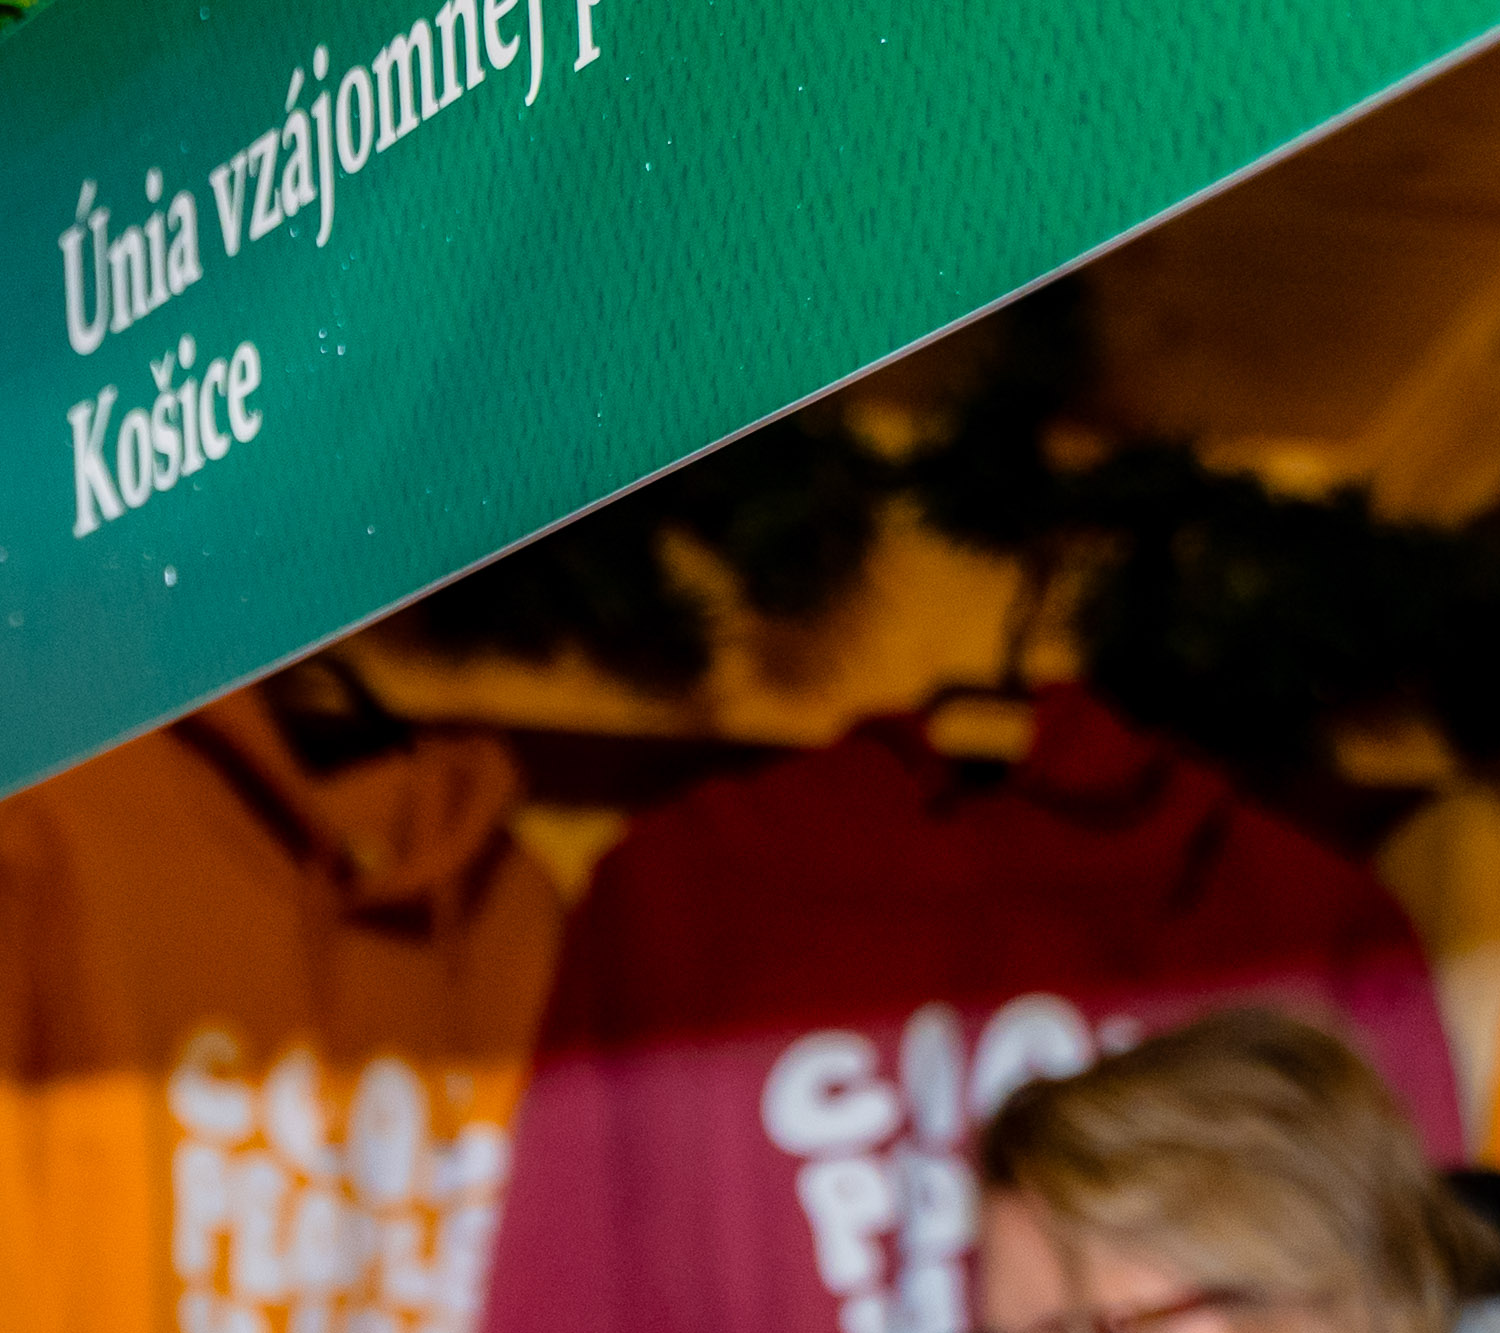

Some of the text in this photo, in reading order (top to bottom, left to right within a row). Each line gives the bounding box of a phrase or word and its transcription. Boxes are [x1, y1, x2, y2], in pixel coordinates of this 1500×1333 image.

[59, 0, 544, 355] Únia vzájomnej
[67, 333, 264, 538] Košice
